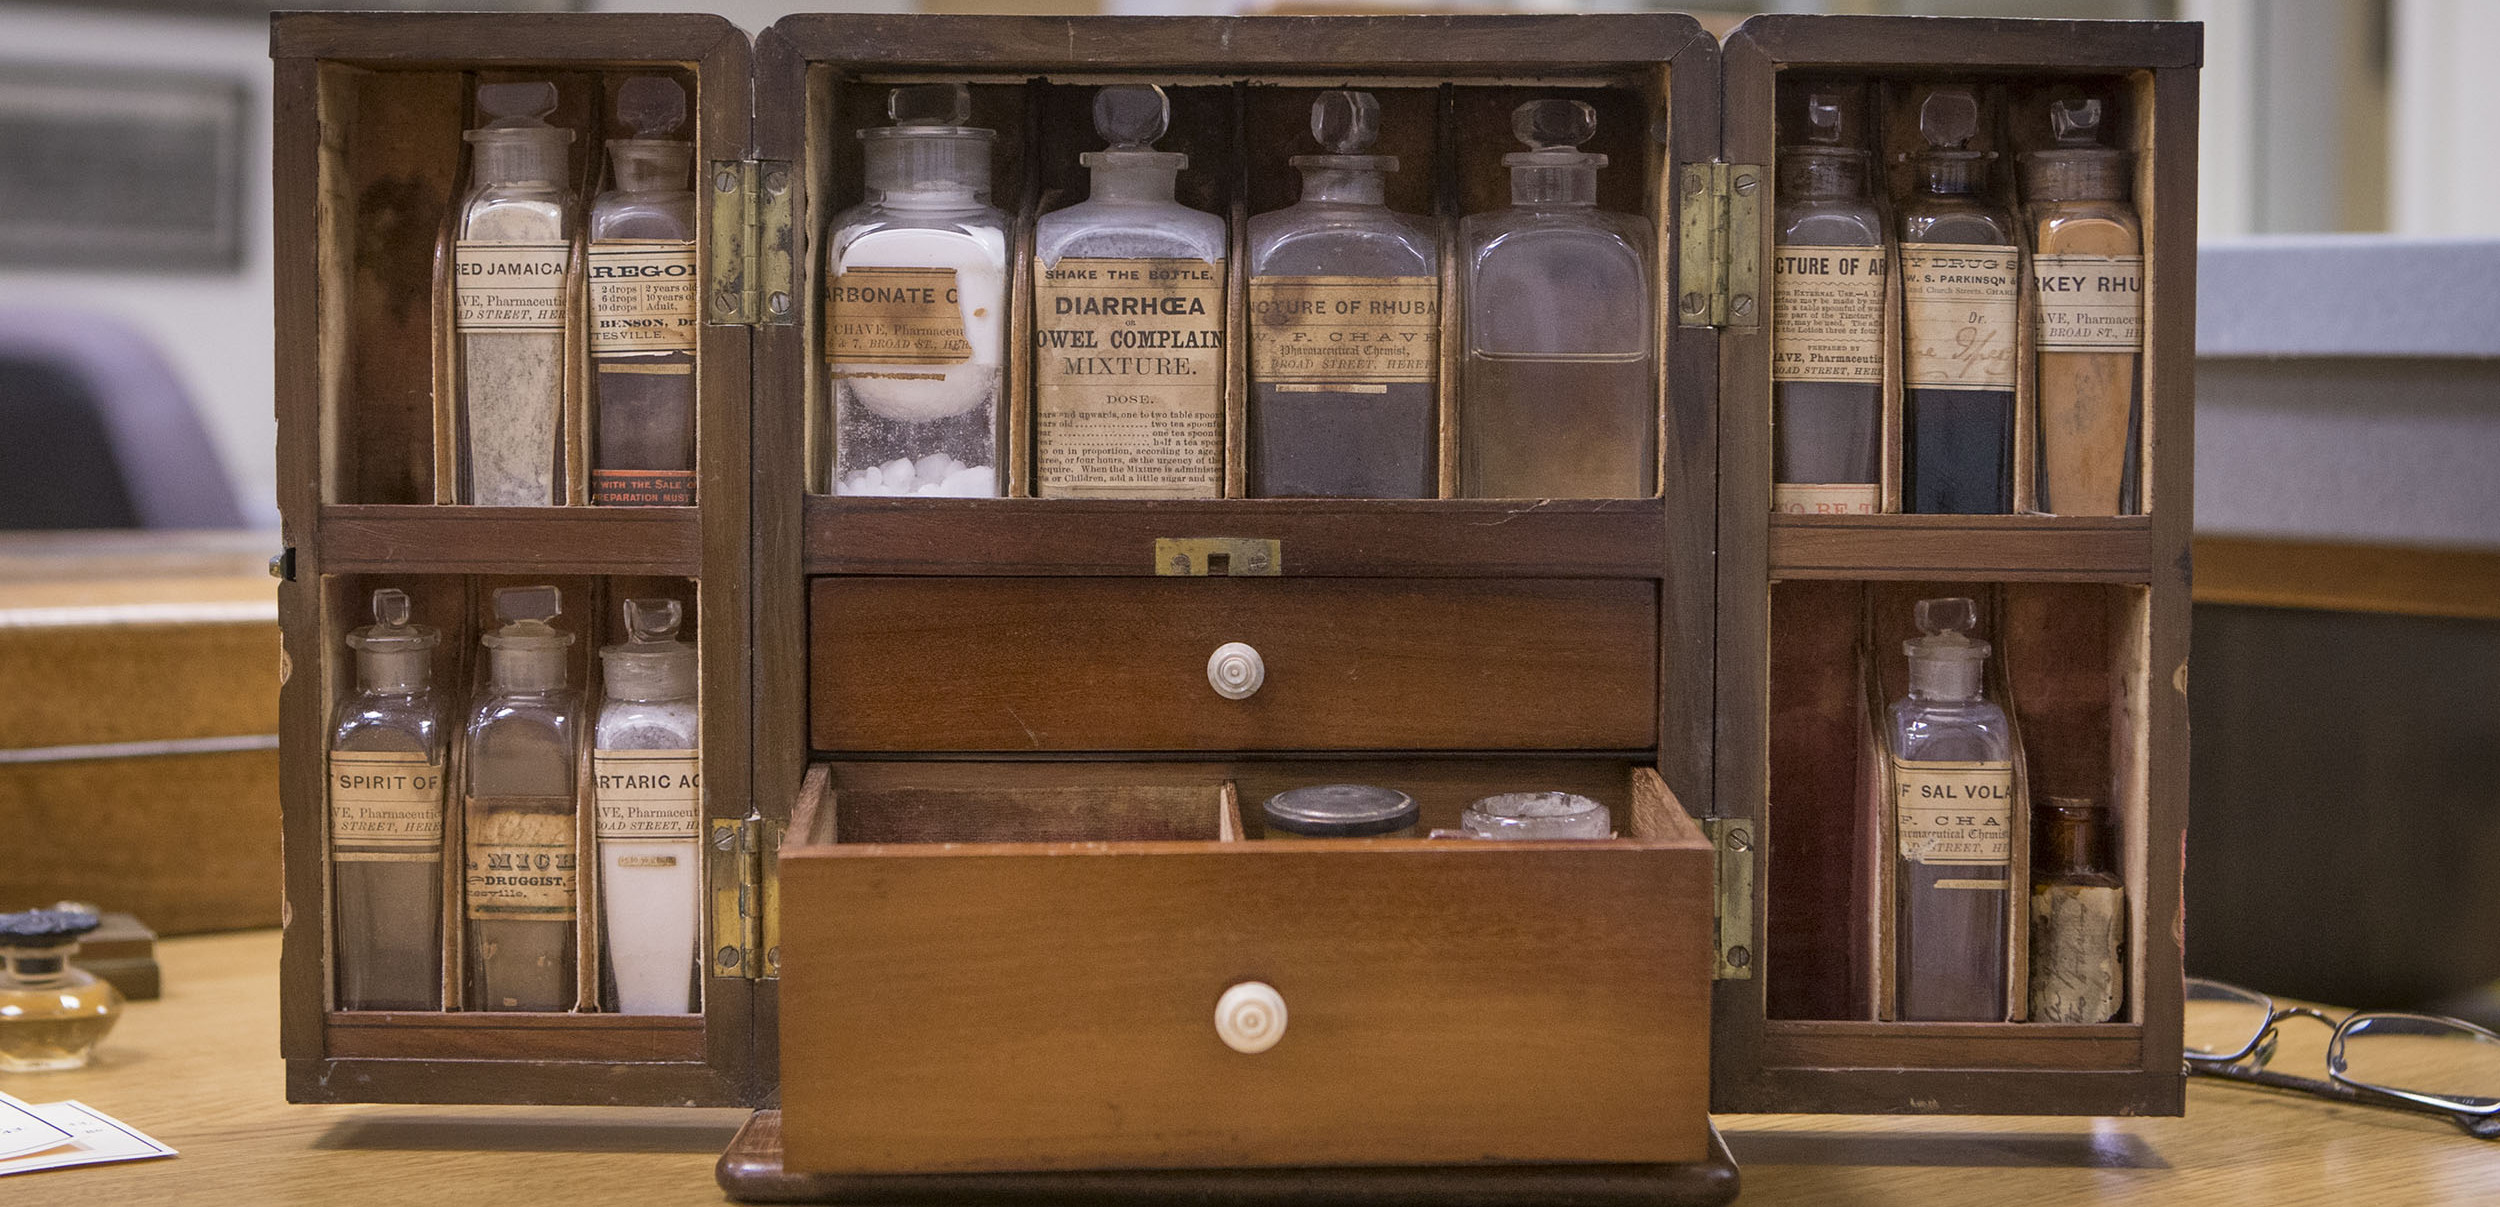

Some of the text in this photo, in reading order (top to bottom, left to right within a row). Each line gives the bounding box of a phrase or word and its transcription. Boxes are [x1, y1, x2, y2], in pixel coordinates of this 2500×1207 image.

[487, 262, 563, 276] JAMAICA
[1839, 257, 1860, 276] OF
[1931, 258, 1999, 269] DRUG
[1044, 270, 1214, 281] SHAKE THE BOTTLE.
[1924, 274, 1935, 283] S.
[2098, 276, 2141, 292] RHU
[610, 285, 637, 296] drops
[653, 286, 680, 297] years
[610, 294, 637, 305] drops
[657, 295, 683, 304] years
[610, 303, 637, 313] drops
[1055, 296, 1206, 316] DIARRHŒA
[1335, 300, 1361, 315] OF
[477, 310, 532, 321] STREET,
[1968, 311, 1987, 324] Dr.
[834, 323, 888, 337] CHAVE,
[2049, 327, 2092, 338] BROAD
[1293, 332, 1313, 342] F.
[869, 339, 910, 350] BROAD
[1280, 344, 1410, 357] Pharmaceutical Chemist,
[1062, 356, 1198, 376] MIXTURE.
[1271, 359, 1314, 370] BROAD
[1322, 359, 1377, 371] STREET,
[1803, 366, 1850, 376] STREET,
[1106, 394, 1155, 404] DOSE.
[1151, 410, 1168, 419] two
[1170, 410, 1193, 419] table
[1068, 447, 1078, 455] in
[1082, 447, 1133, 457] proportion,
[1136, 447, 1181, 457] according
[1096, 456, 1125, 465] hours,
[1140, 456, 1155, 464] the
[1157, 457, 1193, 466] urgency
[1081, 465, 1107, 473] When
[1109, 465, 1125, 473] the
[1126, 465, 1162, 473] Mixture
[1064, 474, 1107, 483] Children,
[1136, 474, 1159, 482] little
[1188, 474, 1205, 482] and
[601, 481, 626, 489] WITH
[631, 481, 652, 489] THE
[340, 775, 438, 790] SPIRIT OF
[1921, 785, 1957, 799] SAL
[341, 821, 397, 834] STREET,
[630, 821, 681, 832] STREET,
[485, 876, 566, 887] DRUGGIST,
